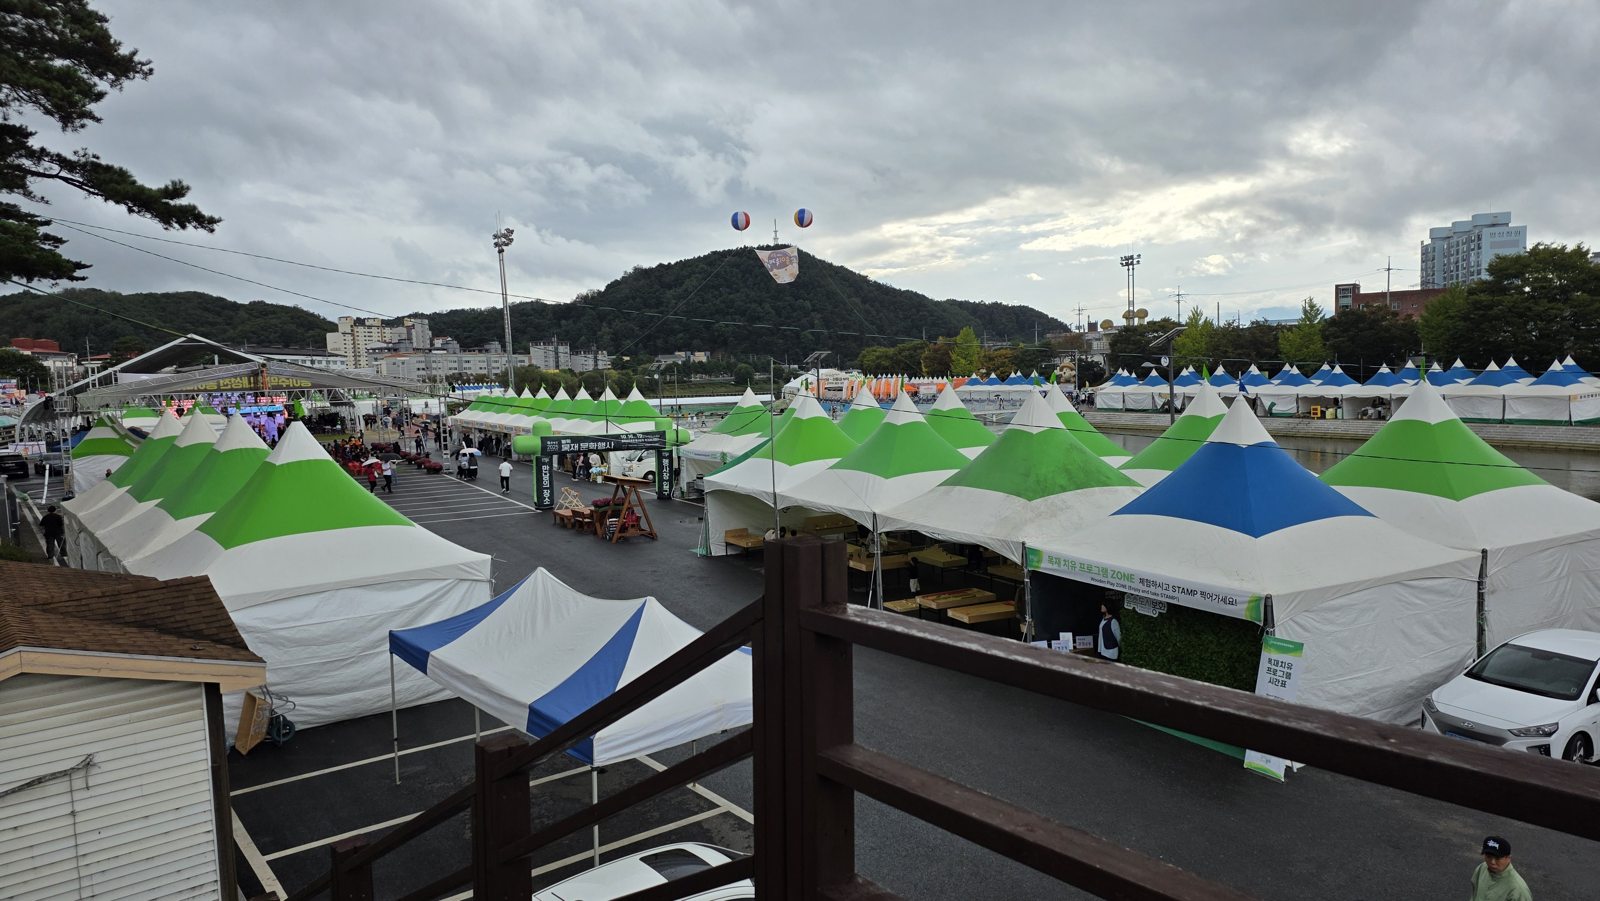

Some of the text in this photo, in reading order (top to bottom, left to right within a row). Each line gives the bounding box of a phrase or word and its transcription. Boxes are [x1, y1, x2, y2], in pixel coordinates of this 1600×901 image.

[541, 464, 550, 488] 만남의
[542, 489, 551, 505] 장소
[1047, 555, 1062, 567] 목재
[1063, 559, 1077, 571] 치유
[1078, 562, 1109, 577] 프로그램
[1110, 569, 1135, 584] ZONE
[1138, 577, 1170, 591] 체험하시고
[1171, 586, 1198, 597] STAMP
[1199, 590, 1238, 607] 찍어가세요!
[1116, 582, 1127, 590] ZONE
[1267, 657, 1293, 671] 목재치유
[1266, 666, 1292, 680] 프로그램
[1268, 677, 1287, 688] 시간표
